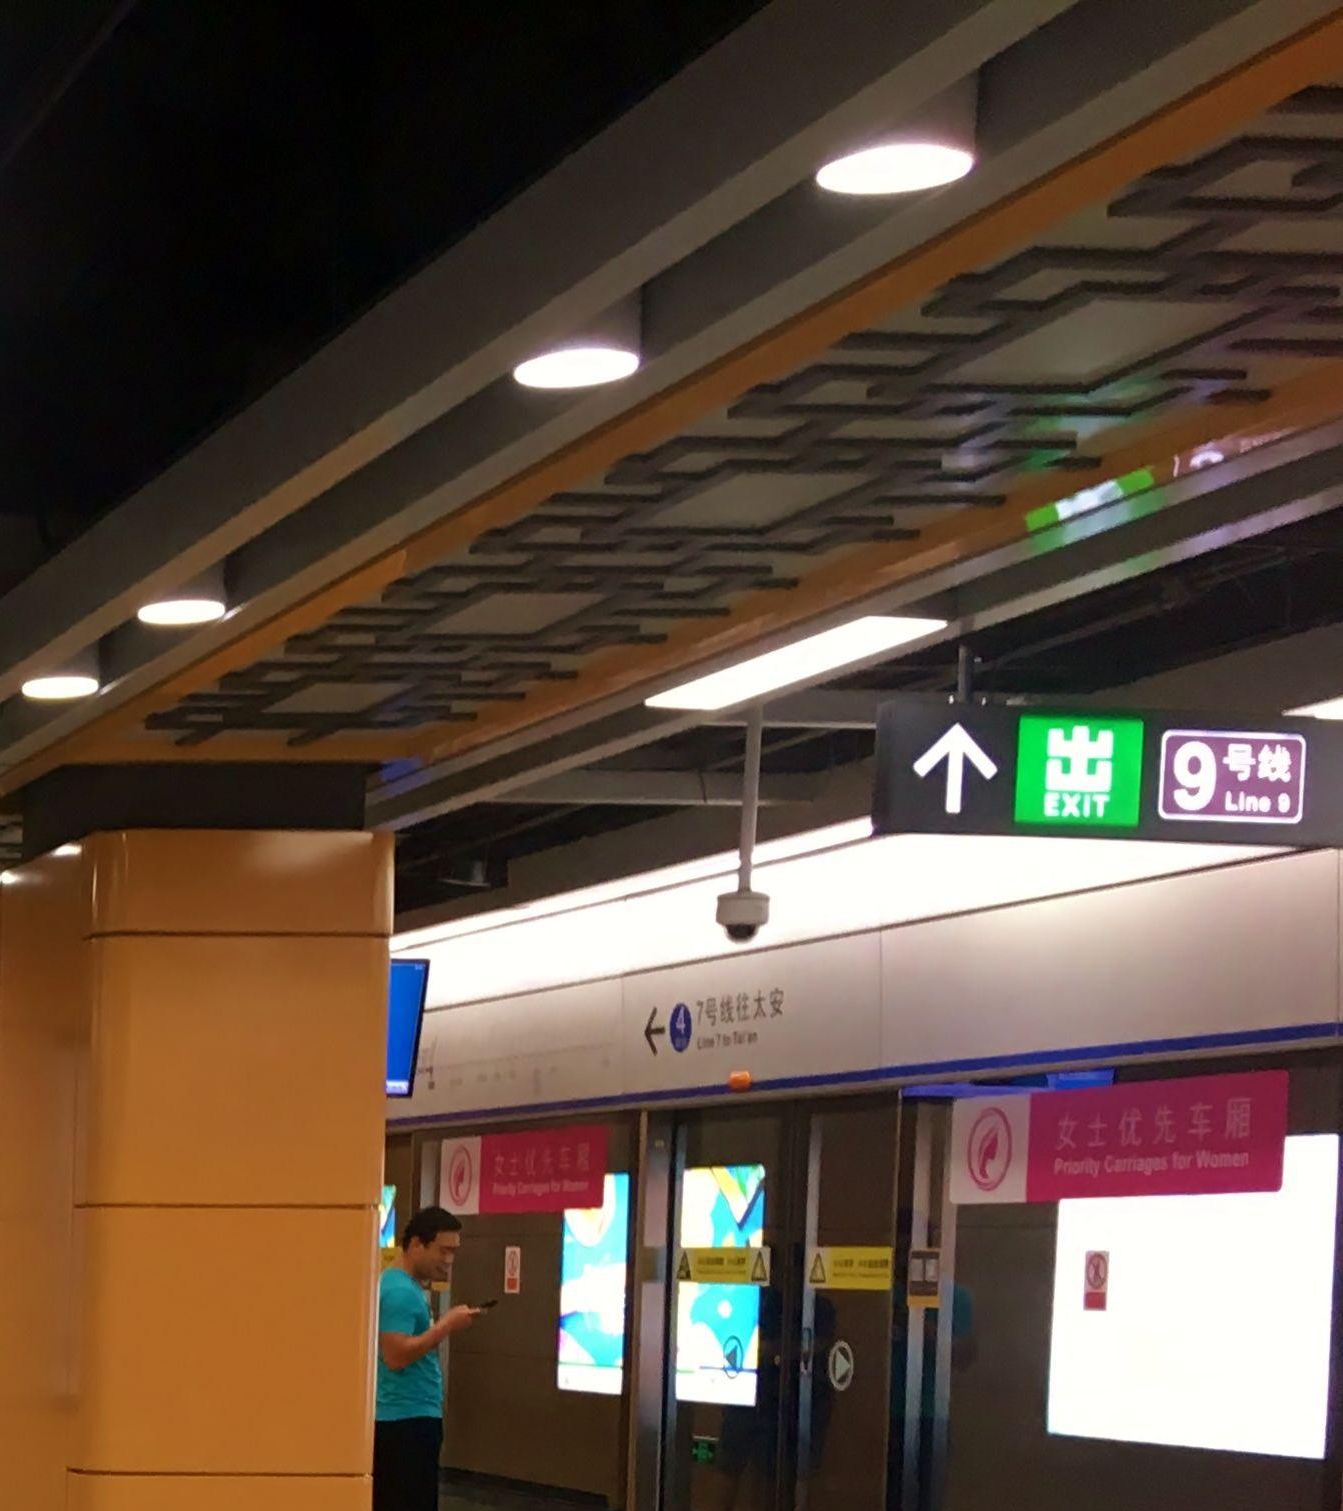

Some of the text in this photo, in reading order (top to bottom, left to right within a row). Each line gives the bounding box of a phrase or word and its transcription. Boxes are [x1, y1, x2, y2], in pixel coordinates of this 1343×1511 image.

[1173, 741, 1217, 811] 9
[1044, 792, 1110, 817] EXIT
[1225, 790, 1271, 813] Line
[696, 987, 784, 1027] 7号线往太安
[1056, 1097, 1253, 1150] 女士优先车厢
[1054, 1148, 1249, 1178] Priority Carriages for Women
